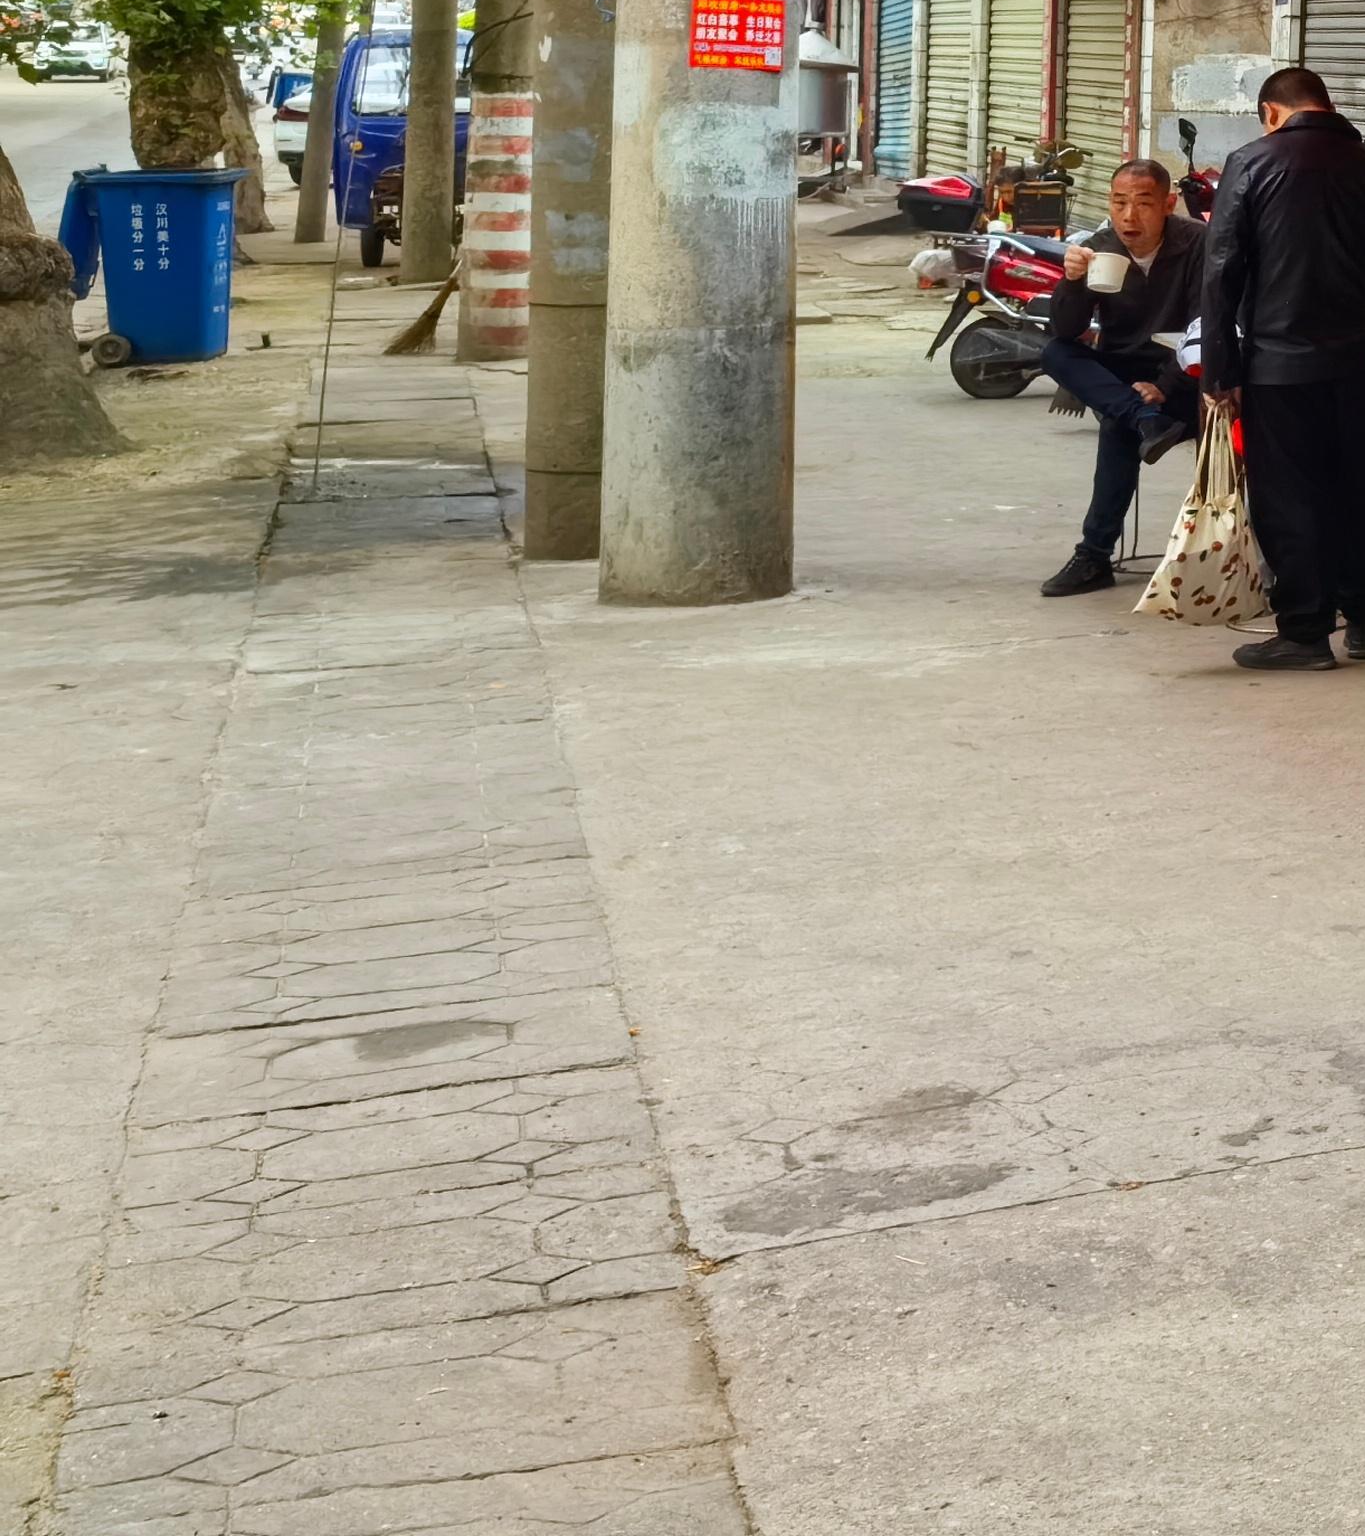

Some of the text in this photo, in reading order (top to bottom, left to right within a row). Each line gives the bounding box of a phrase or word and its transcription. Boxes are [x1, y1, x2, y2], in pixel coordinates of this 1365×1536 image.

[155, 203, 171, 270] 汉川美十分
